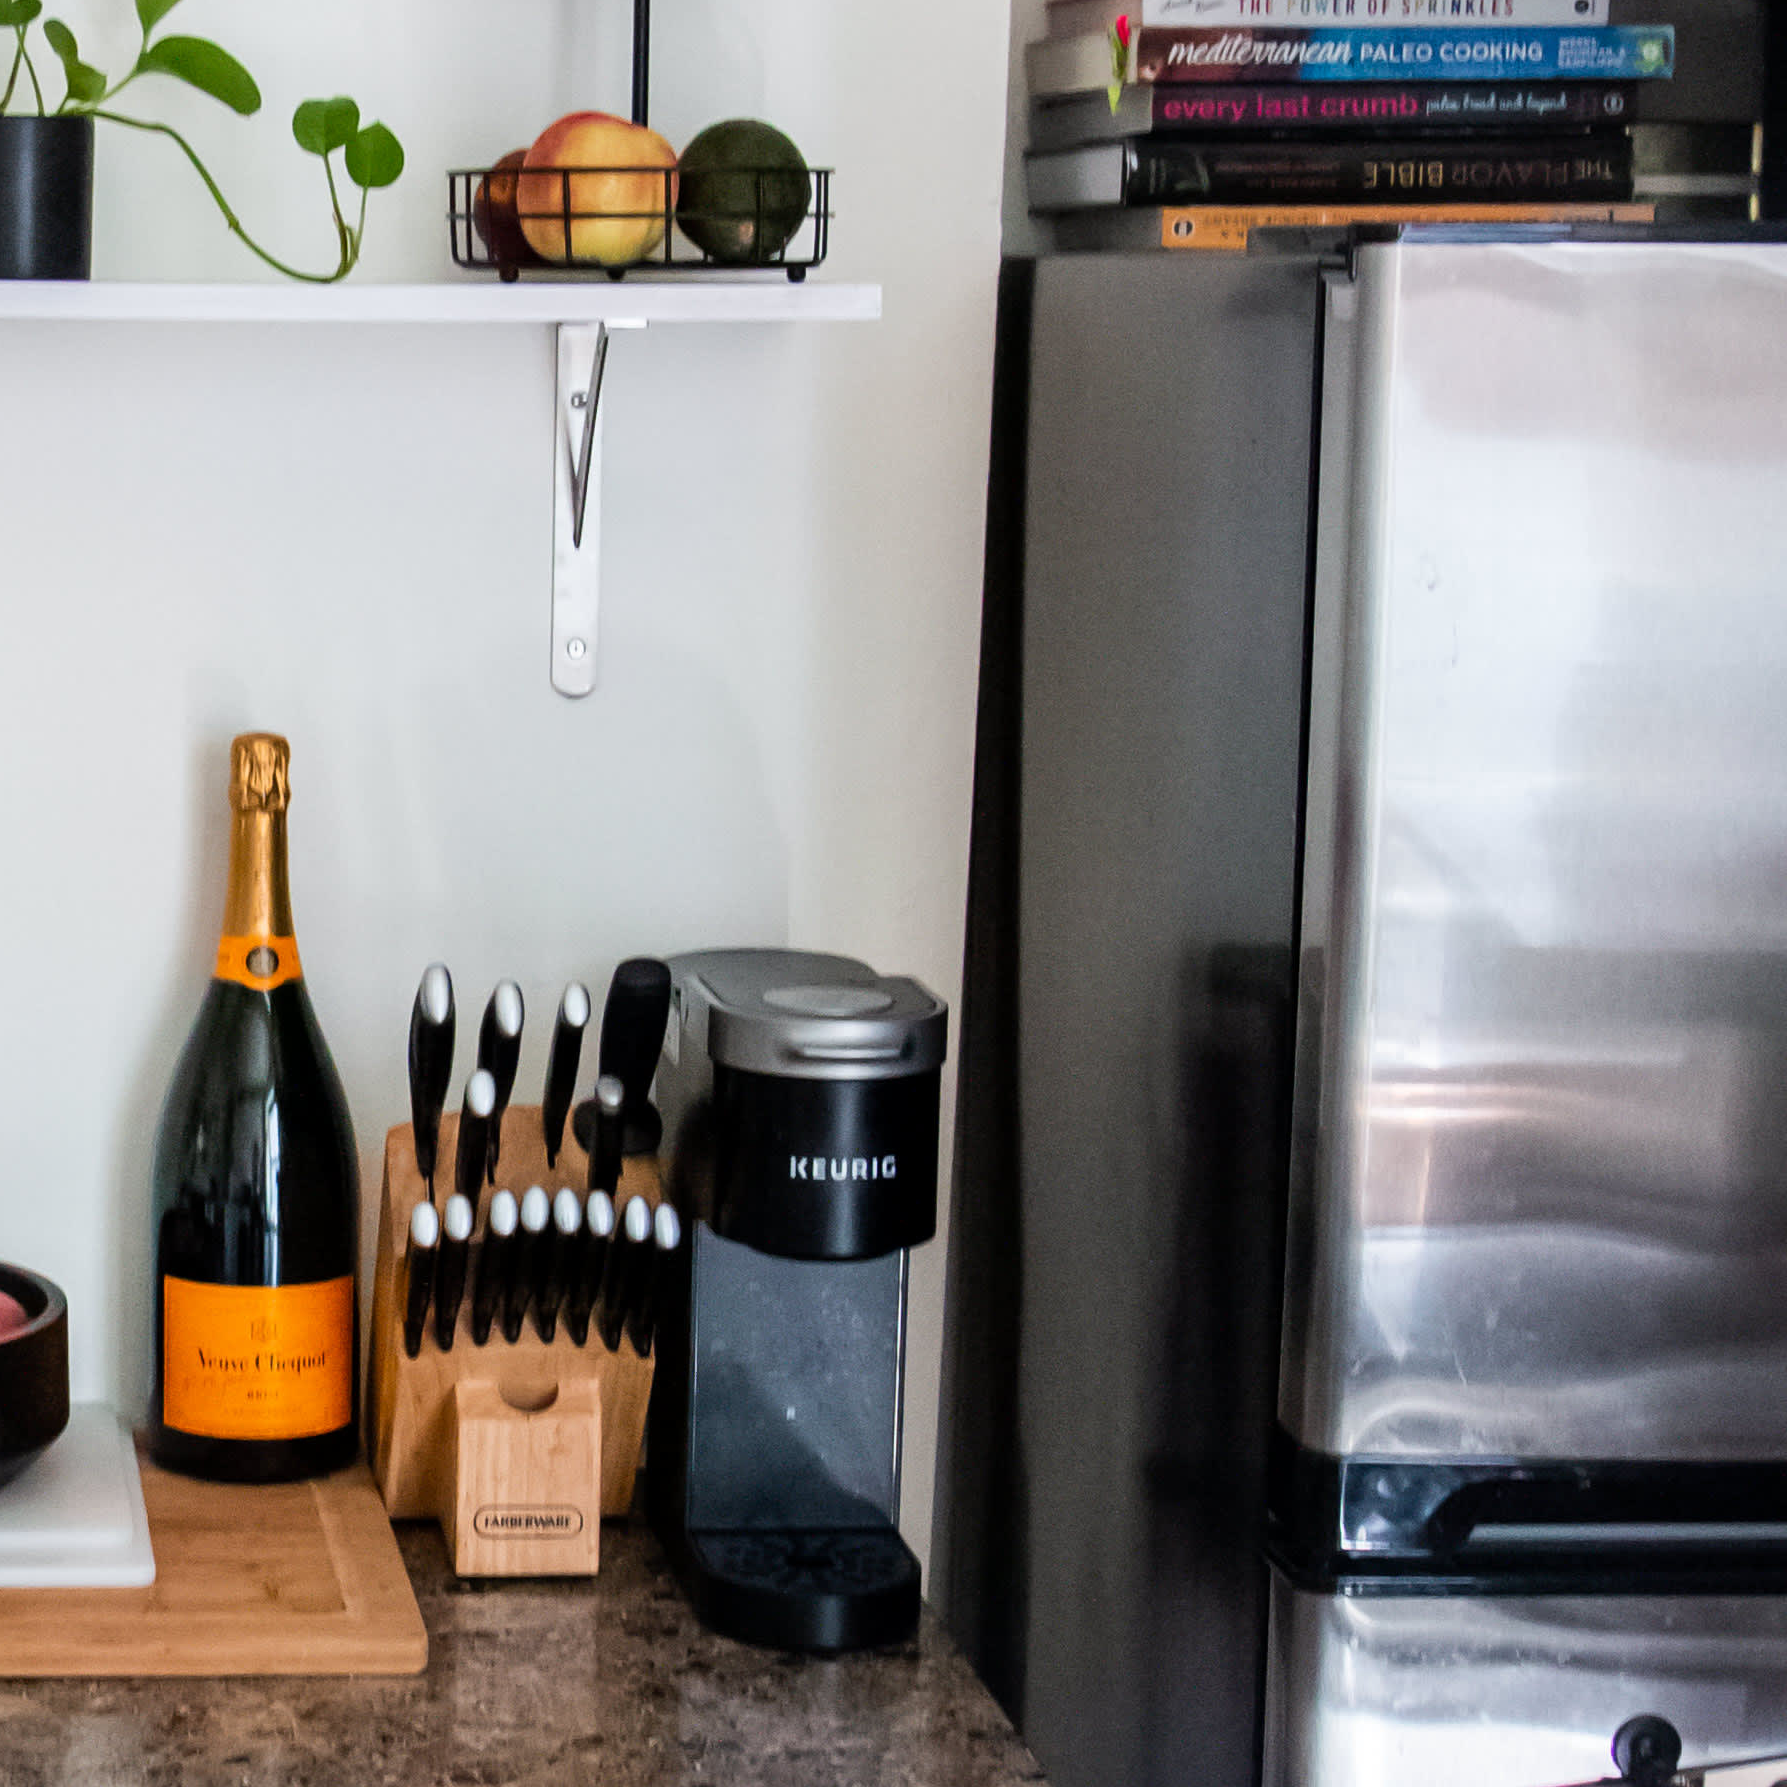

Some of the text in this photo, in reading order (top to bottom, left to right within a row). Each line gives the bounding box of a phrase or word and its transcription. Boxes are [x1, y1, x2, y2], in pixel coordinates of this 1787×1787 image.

[1167, 33, 1353, 66] mediterranean
[1360, 42, 1433, 63] PALEO
[1439, 41, 1544, 63] COOKING
[1164, 92, 1419, 122] every last crumb
[1362, 159, 1444, 189] BIBLE
[1449, 160, 1570, 188] FLAVOR
[789, 1155, 896, 1181] KEURIG
[198, 1348, 326, 1377] Veuve Clicquot
[484, 1514, 571, 1530] FARBERWARE
